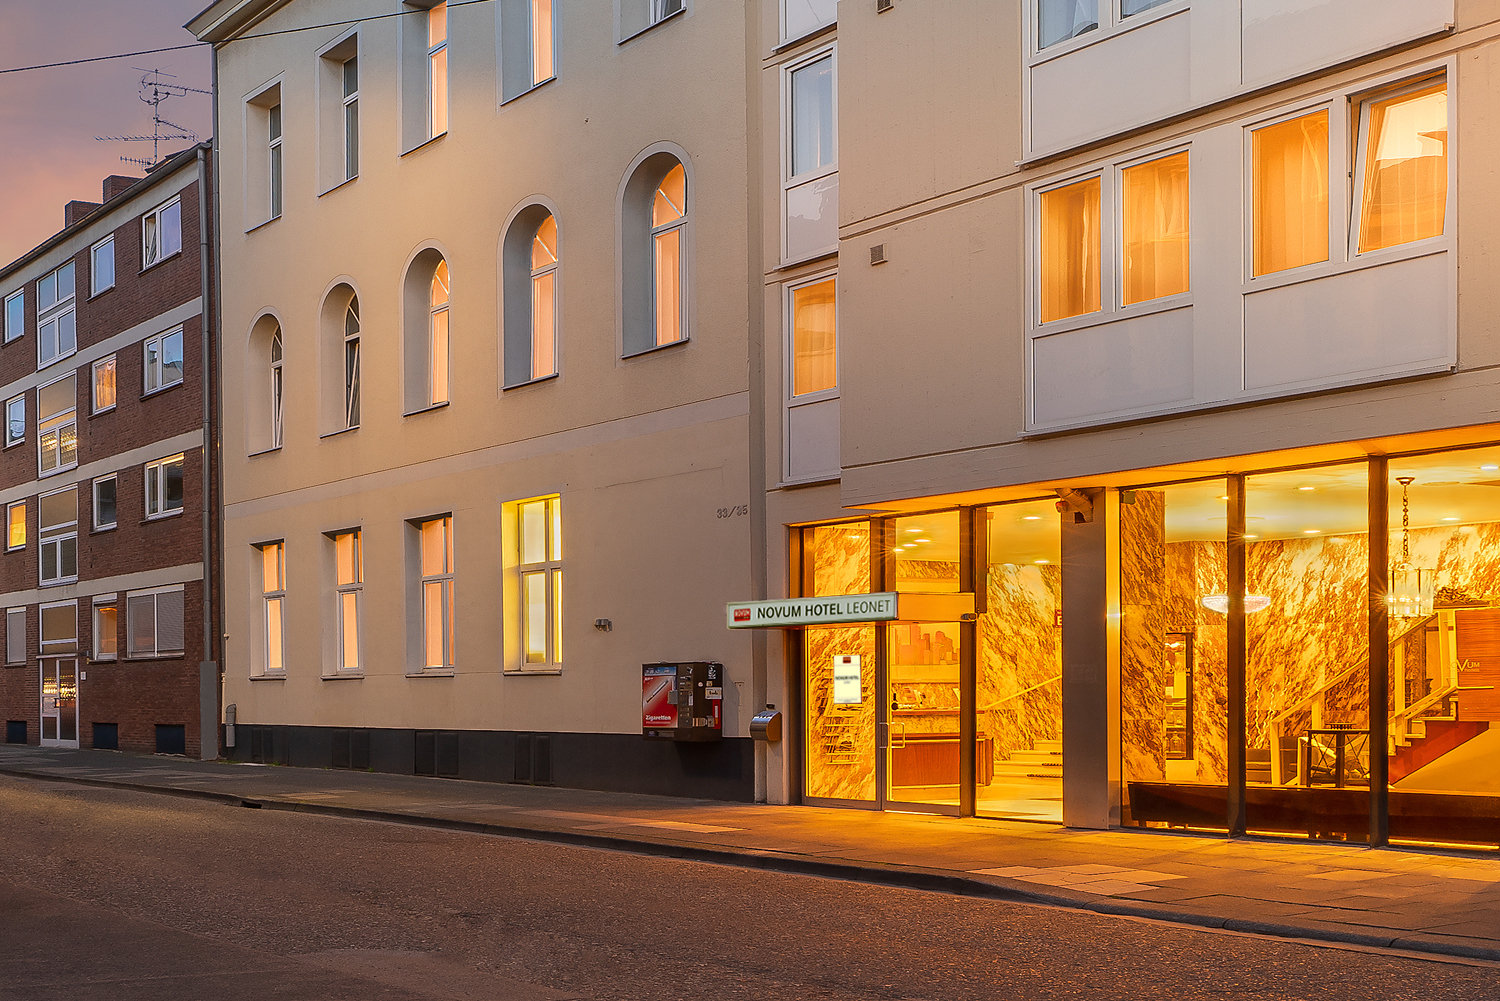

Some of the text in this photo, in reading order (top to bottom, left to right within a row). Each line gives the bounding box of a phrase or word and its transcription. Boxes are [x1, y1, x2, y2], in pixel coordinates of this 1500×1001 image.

[757, 600, 891, 619] NOVUM HOTEL LEONET
[645, 714, 672, 722] Zigaretten
